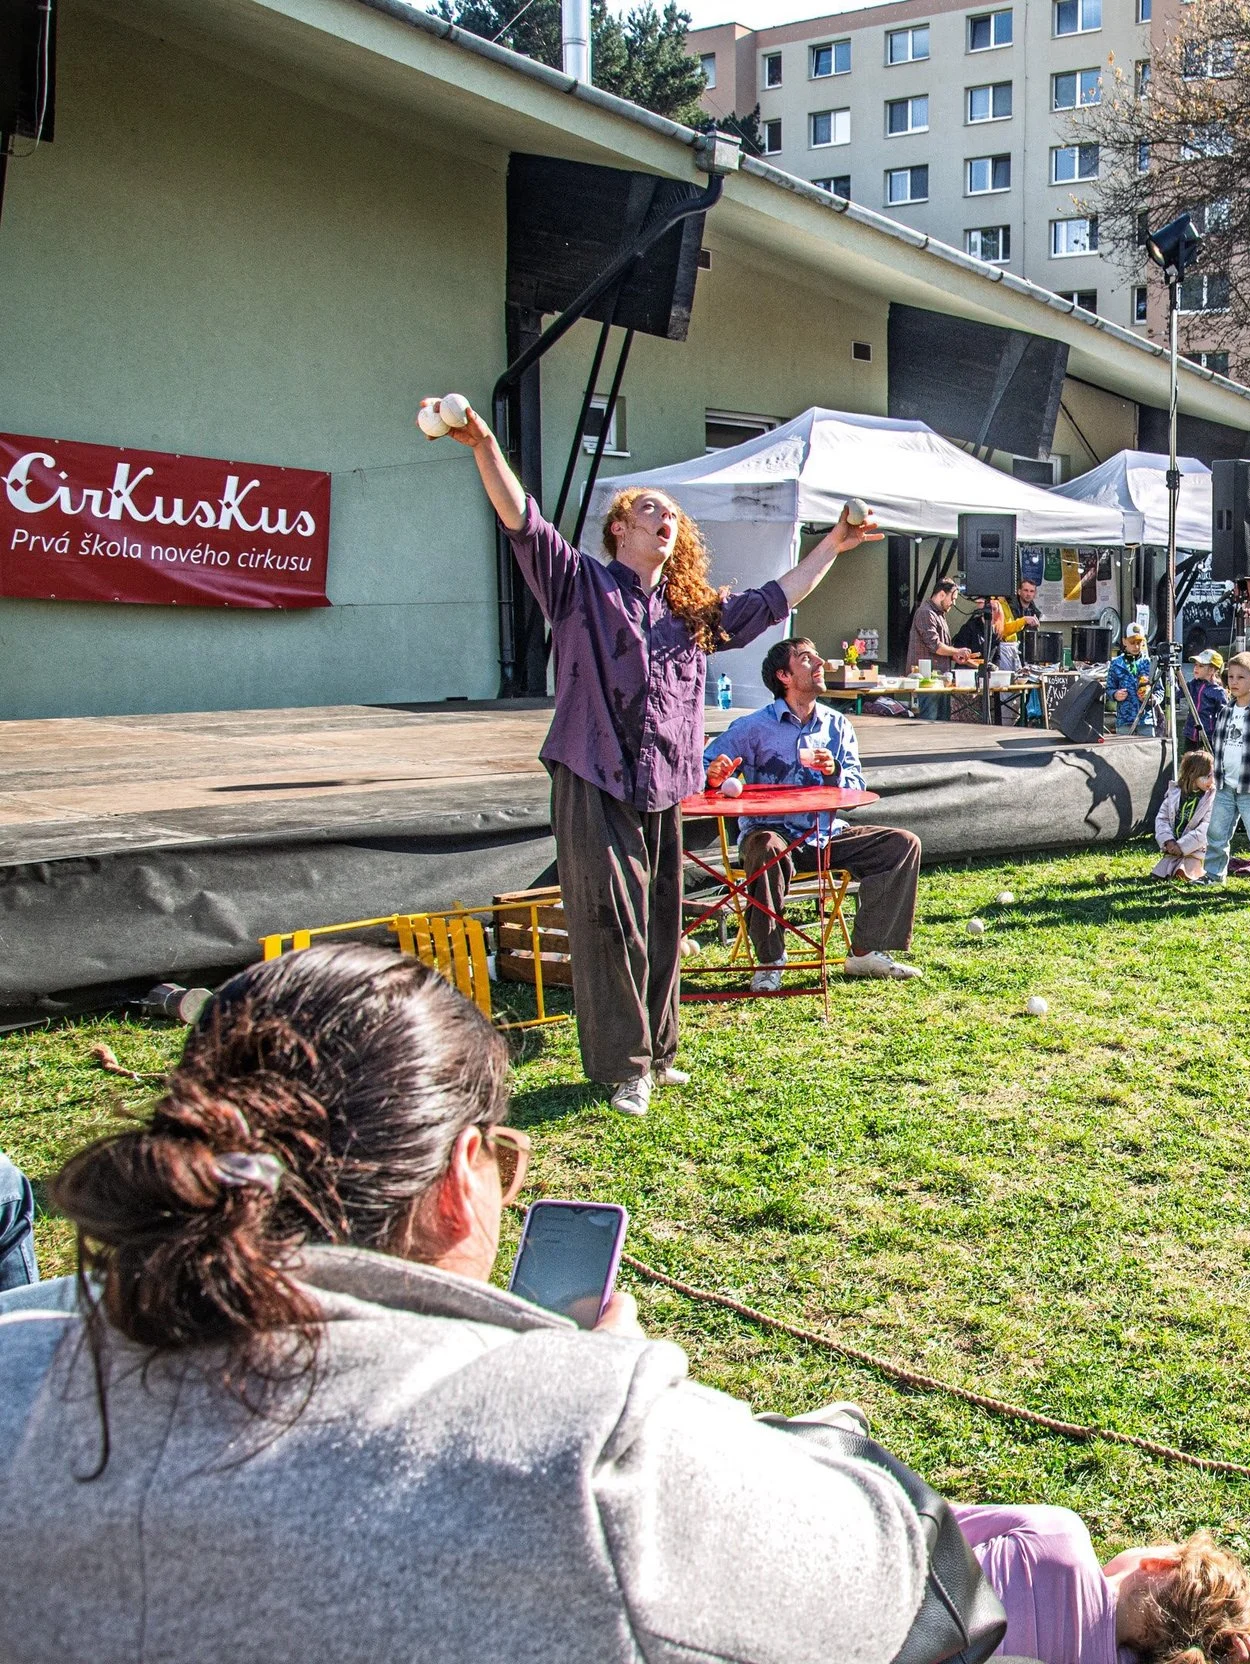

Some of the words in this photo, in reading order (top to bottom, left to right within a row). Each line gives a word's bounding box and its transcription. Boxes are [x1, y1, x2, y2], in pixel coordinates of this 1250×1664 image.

[1, 452, 316, 537] CirKusKus
[10, 528, 70, 554] Prvá
[79, 532, 142, 560] škola
[151, 542, 230, 567] nového
[237, 547, 312, 572] cirkusu
